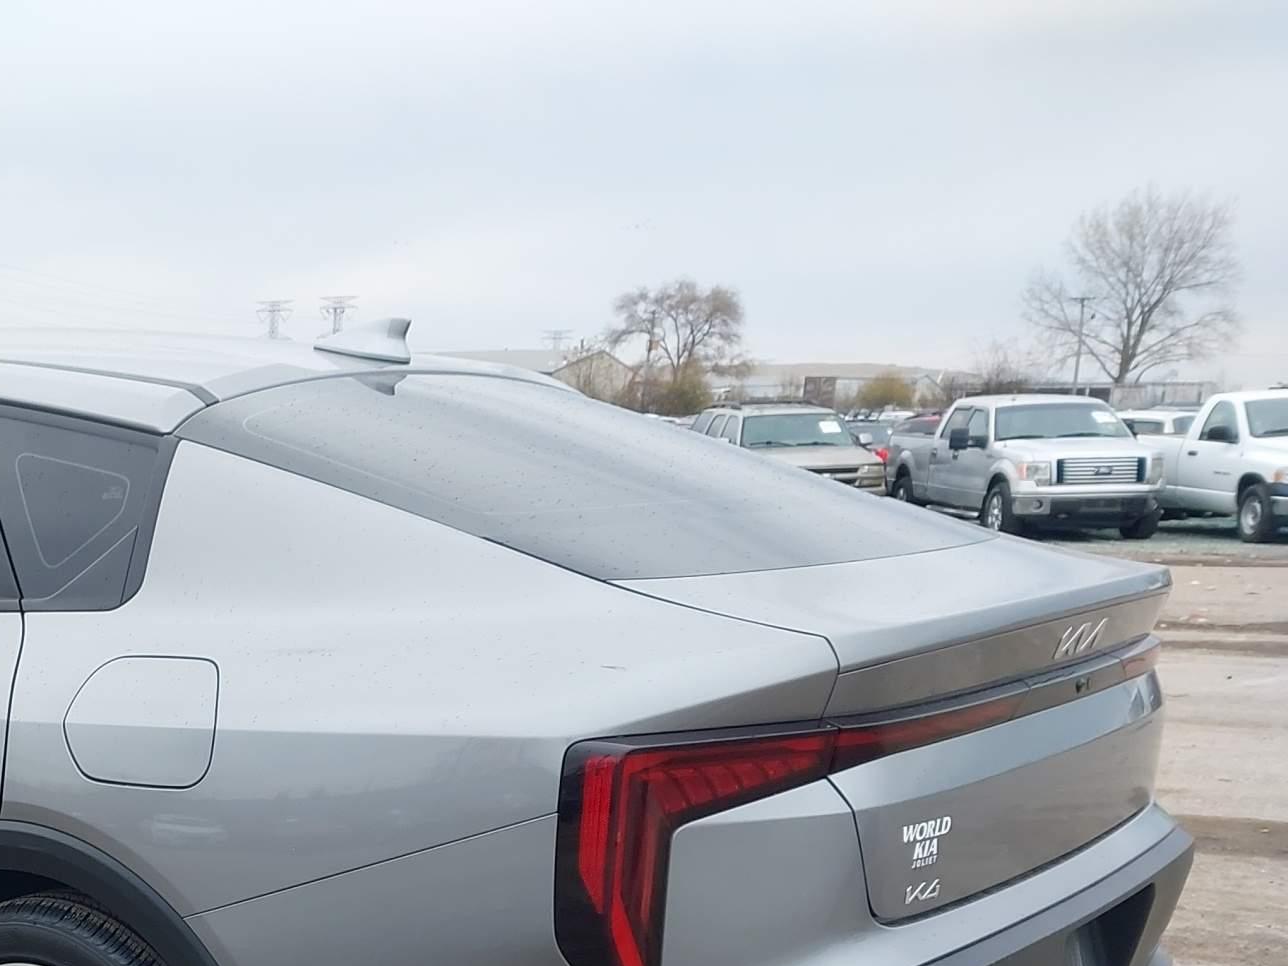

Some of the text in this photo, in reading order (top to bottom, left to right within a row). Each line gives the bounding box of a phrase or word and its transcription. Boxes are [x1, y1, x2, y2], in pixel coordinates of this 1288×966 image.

[902, 816, 952, 843] WORLD
[912, 838, 939, 860] KIA
[911, 855, 938, 869] JOLIET
